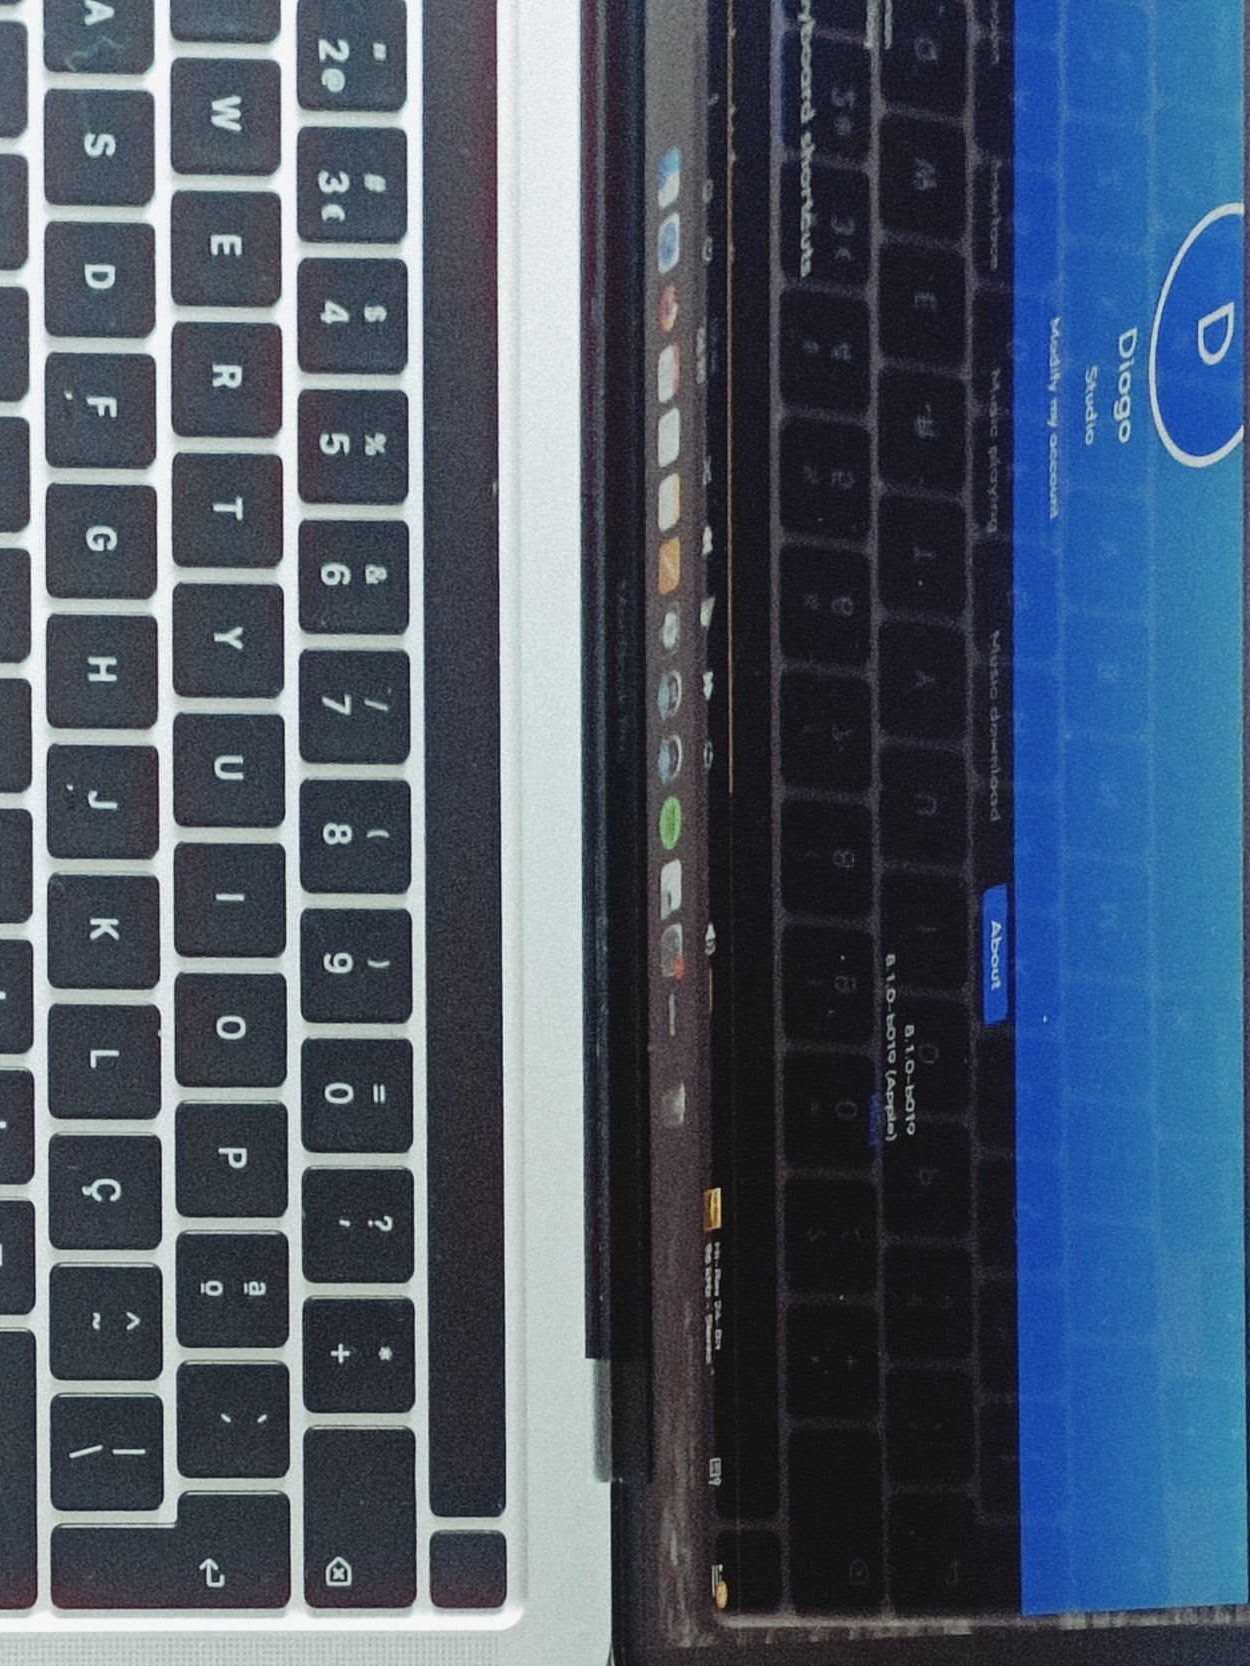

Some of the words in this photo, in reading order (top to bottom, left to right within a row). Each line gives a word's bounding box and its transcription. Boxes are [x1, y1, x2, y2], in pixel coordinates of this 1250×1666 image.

[84, 0, 115, 25] A
[318, 39, 350, 62] 2
[321, 68, 345, 93] @
[211, 95, 242, 132] W
[83, 133, 116, 157] S
[318, 171, 350, 194] 3
[800, 131, 815, 278] shortcuts
[210, 234, 242, 256] E
[84, 264, 116, 290] D
[320, 300, 350, 324] 4
[364, 305, 387, 322] $
[1198, 301, 1235, 365] D
[1047, 316, 1060, 391] Modify
[212, 364, 243, 388] R
[1113, 327, 1138, 444] Diogo
[86, 396, 117, 418] F
[1047, 397, 1057, 428] my
[1084, 364, 1097, 446] Studio
[319, 433, 350, 455] 5
[364, 433, 387, 456] %
[1049, 433, 1058, 520] account
[213, 497, 243, 520] T
[85, 525, 118, 552] G
[320, 562, 351, 586] 6
[365, 564, 388, 584] &
[214, 626, 243, 650] Y
[87, 656, 118, 682] H
[322, 694, 351, 715] 7
[214, 755, 244, 780] U
[87, 790, 118, 810] J
[322, 822, 353, 845] 8
[366, 829, 390, 838] (
[215, 893, 245, 902] I
[89, 918, 119, 940] K
[323, 952, 354, 974] 9
[367, 960, 390, 969] )
[990, 920, 1002, 991] About
[216, 1015, 247, 1040] O
[90, 1049, 120, 1069] L
[324, 1082, 354, 1105] 0
[373, 1084, 386, 1103] =
[884, 1070, 897, 1142] (Apple)
[218, 1147, 248, 1169] P
[81, 1178, 122, 1202] Ç
[367, 1215, 393, 1232] ?
[330, 1343, 351, 1364] +
